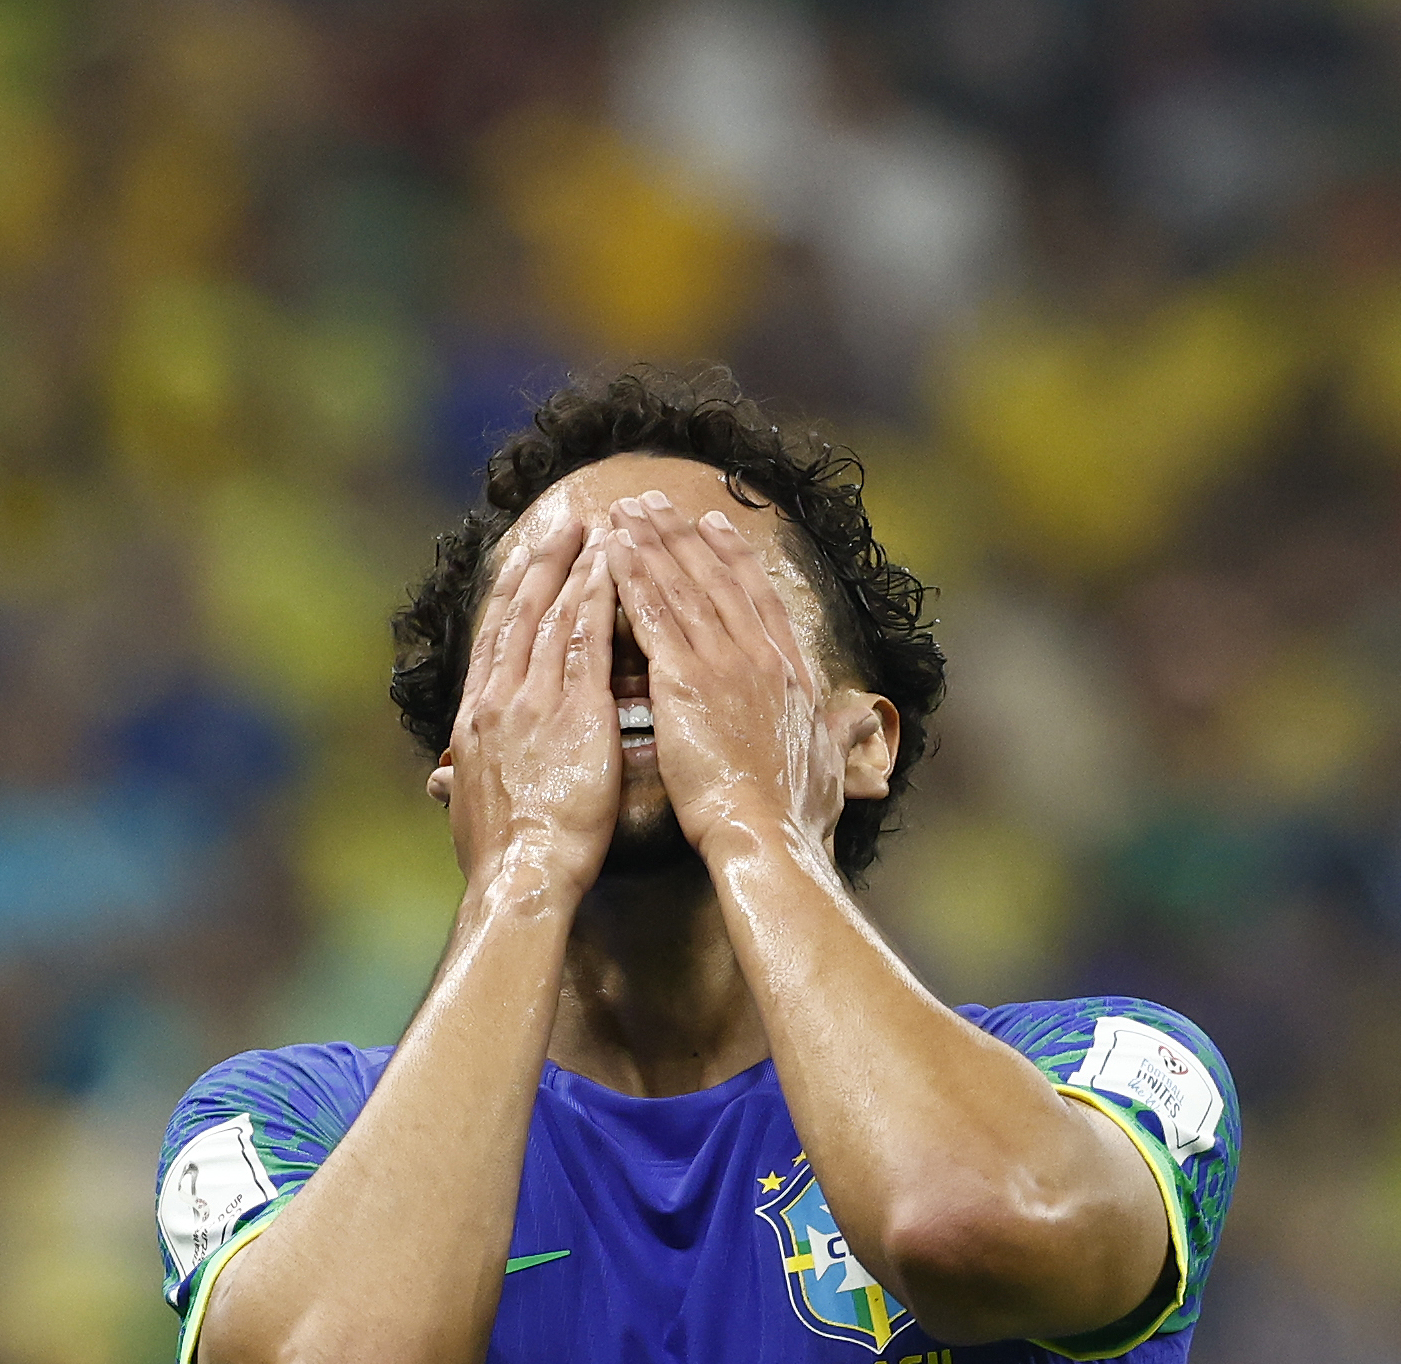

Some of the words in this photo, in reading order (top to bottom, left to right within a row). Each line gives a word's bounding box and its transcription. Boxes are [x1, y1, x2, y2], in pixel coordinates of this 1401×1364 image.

[1137, 1070, 1180, 1118] UNITES
[1140, 1058, 1185, 1107] FOOTBALL
[226, 1194, 243, 1214] CUP
